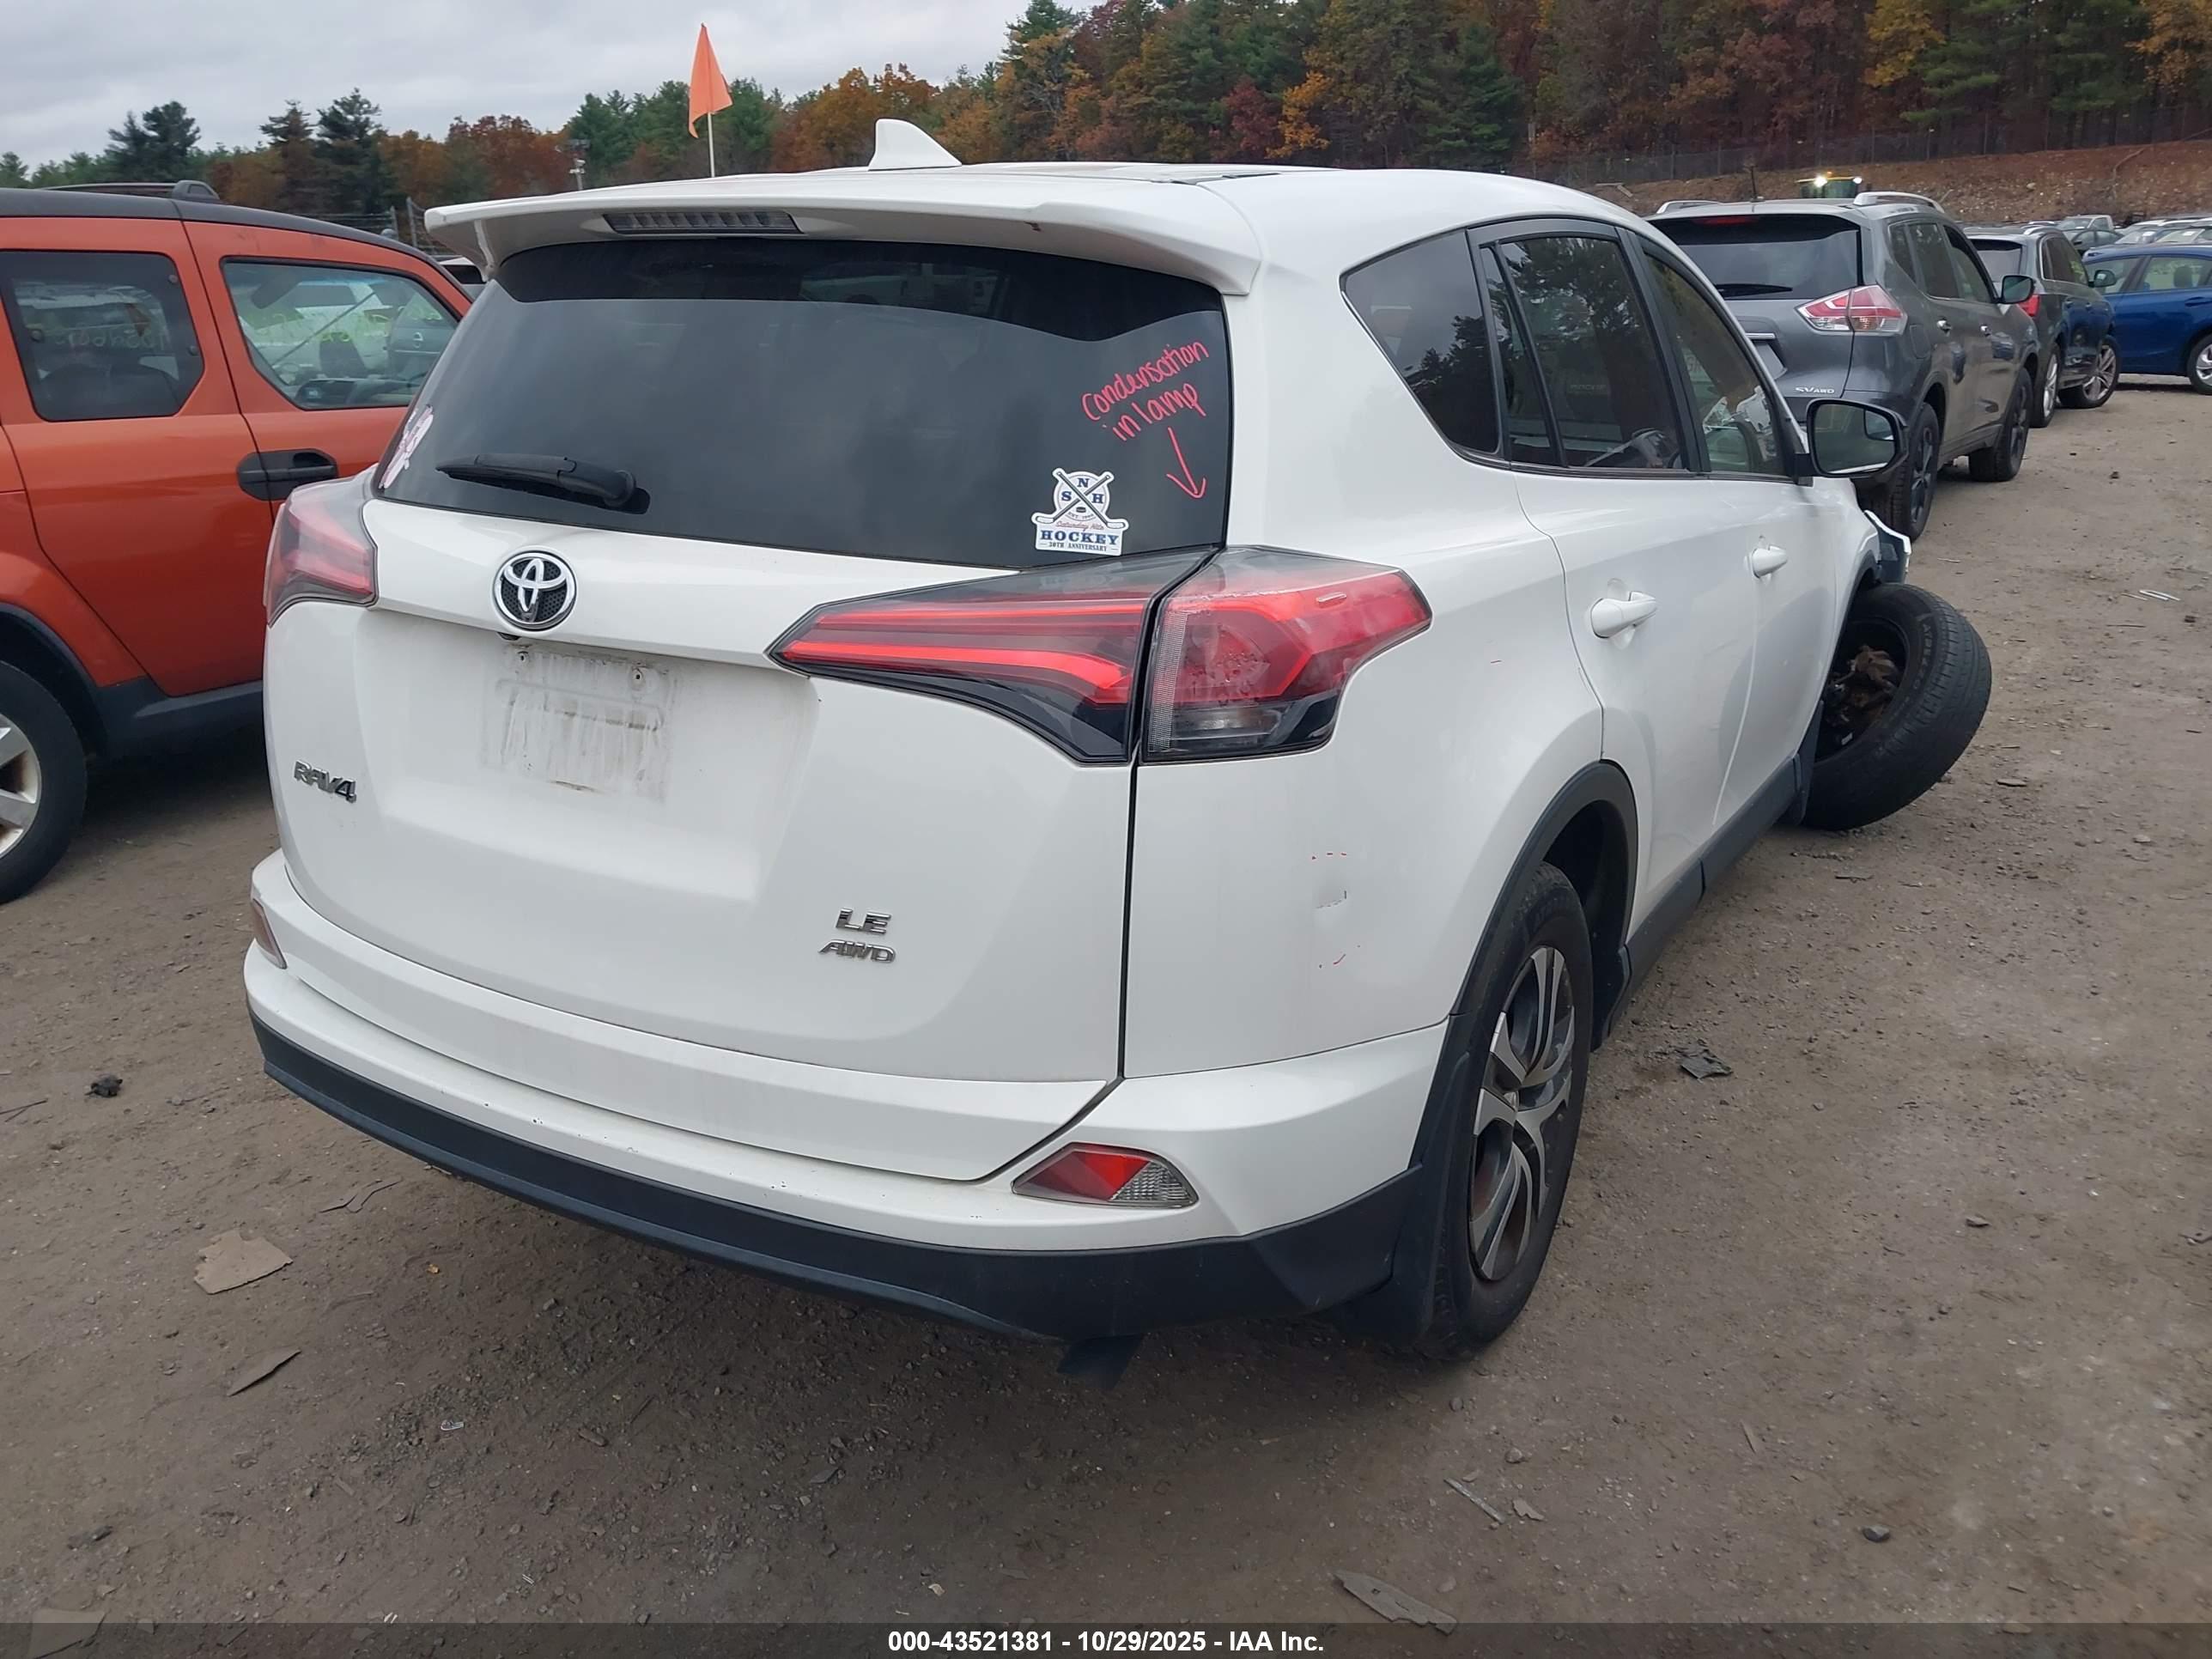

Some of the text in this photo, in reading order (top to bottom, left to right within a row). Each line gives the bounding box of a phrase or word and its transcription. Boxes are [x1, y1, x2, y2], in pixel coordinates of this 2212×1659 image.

[1081, 341, 1210, 421] Condensation
[1102, 383, 1206, 441] in lamp
[1077, 477, 1090, 488] N
[1040, 530, 1119, 545] HOCKEY
[294, 759, 357, 804] RAV4
[835, 908, 892, 935] LE
[817, 939, 896, 963] AWD
